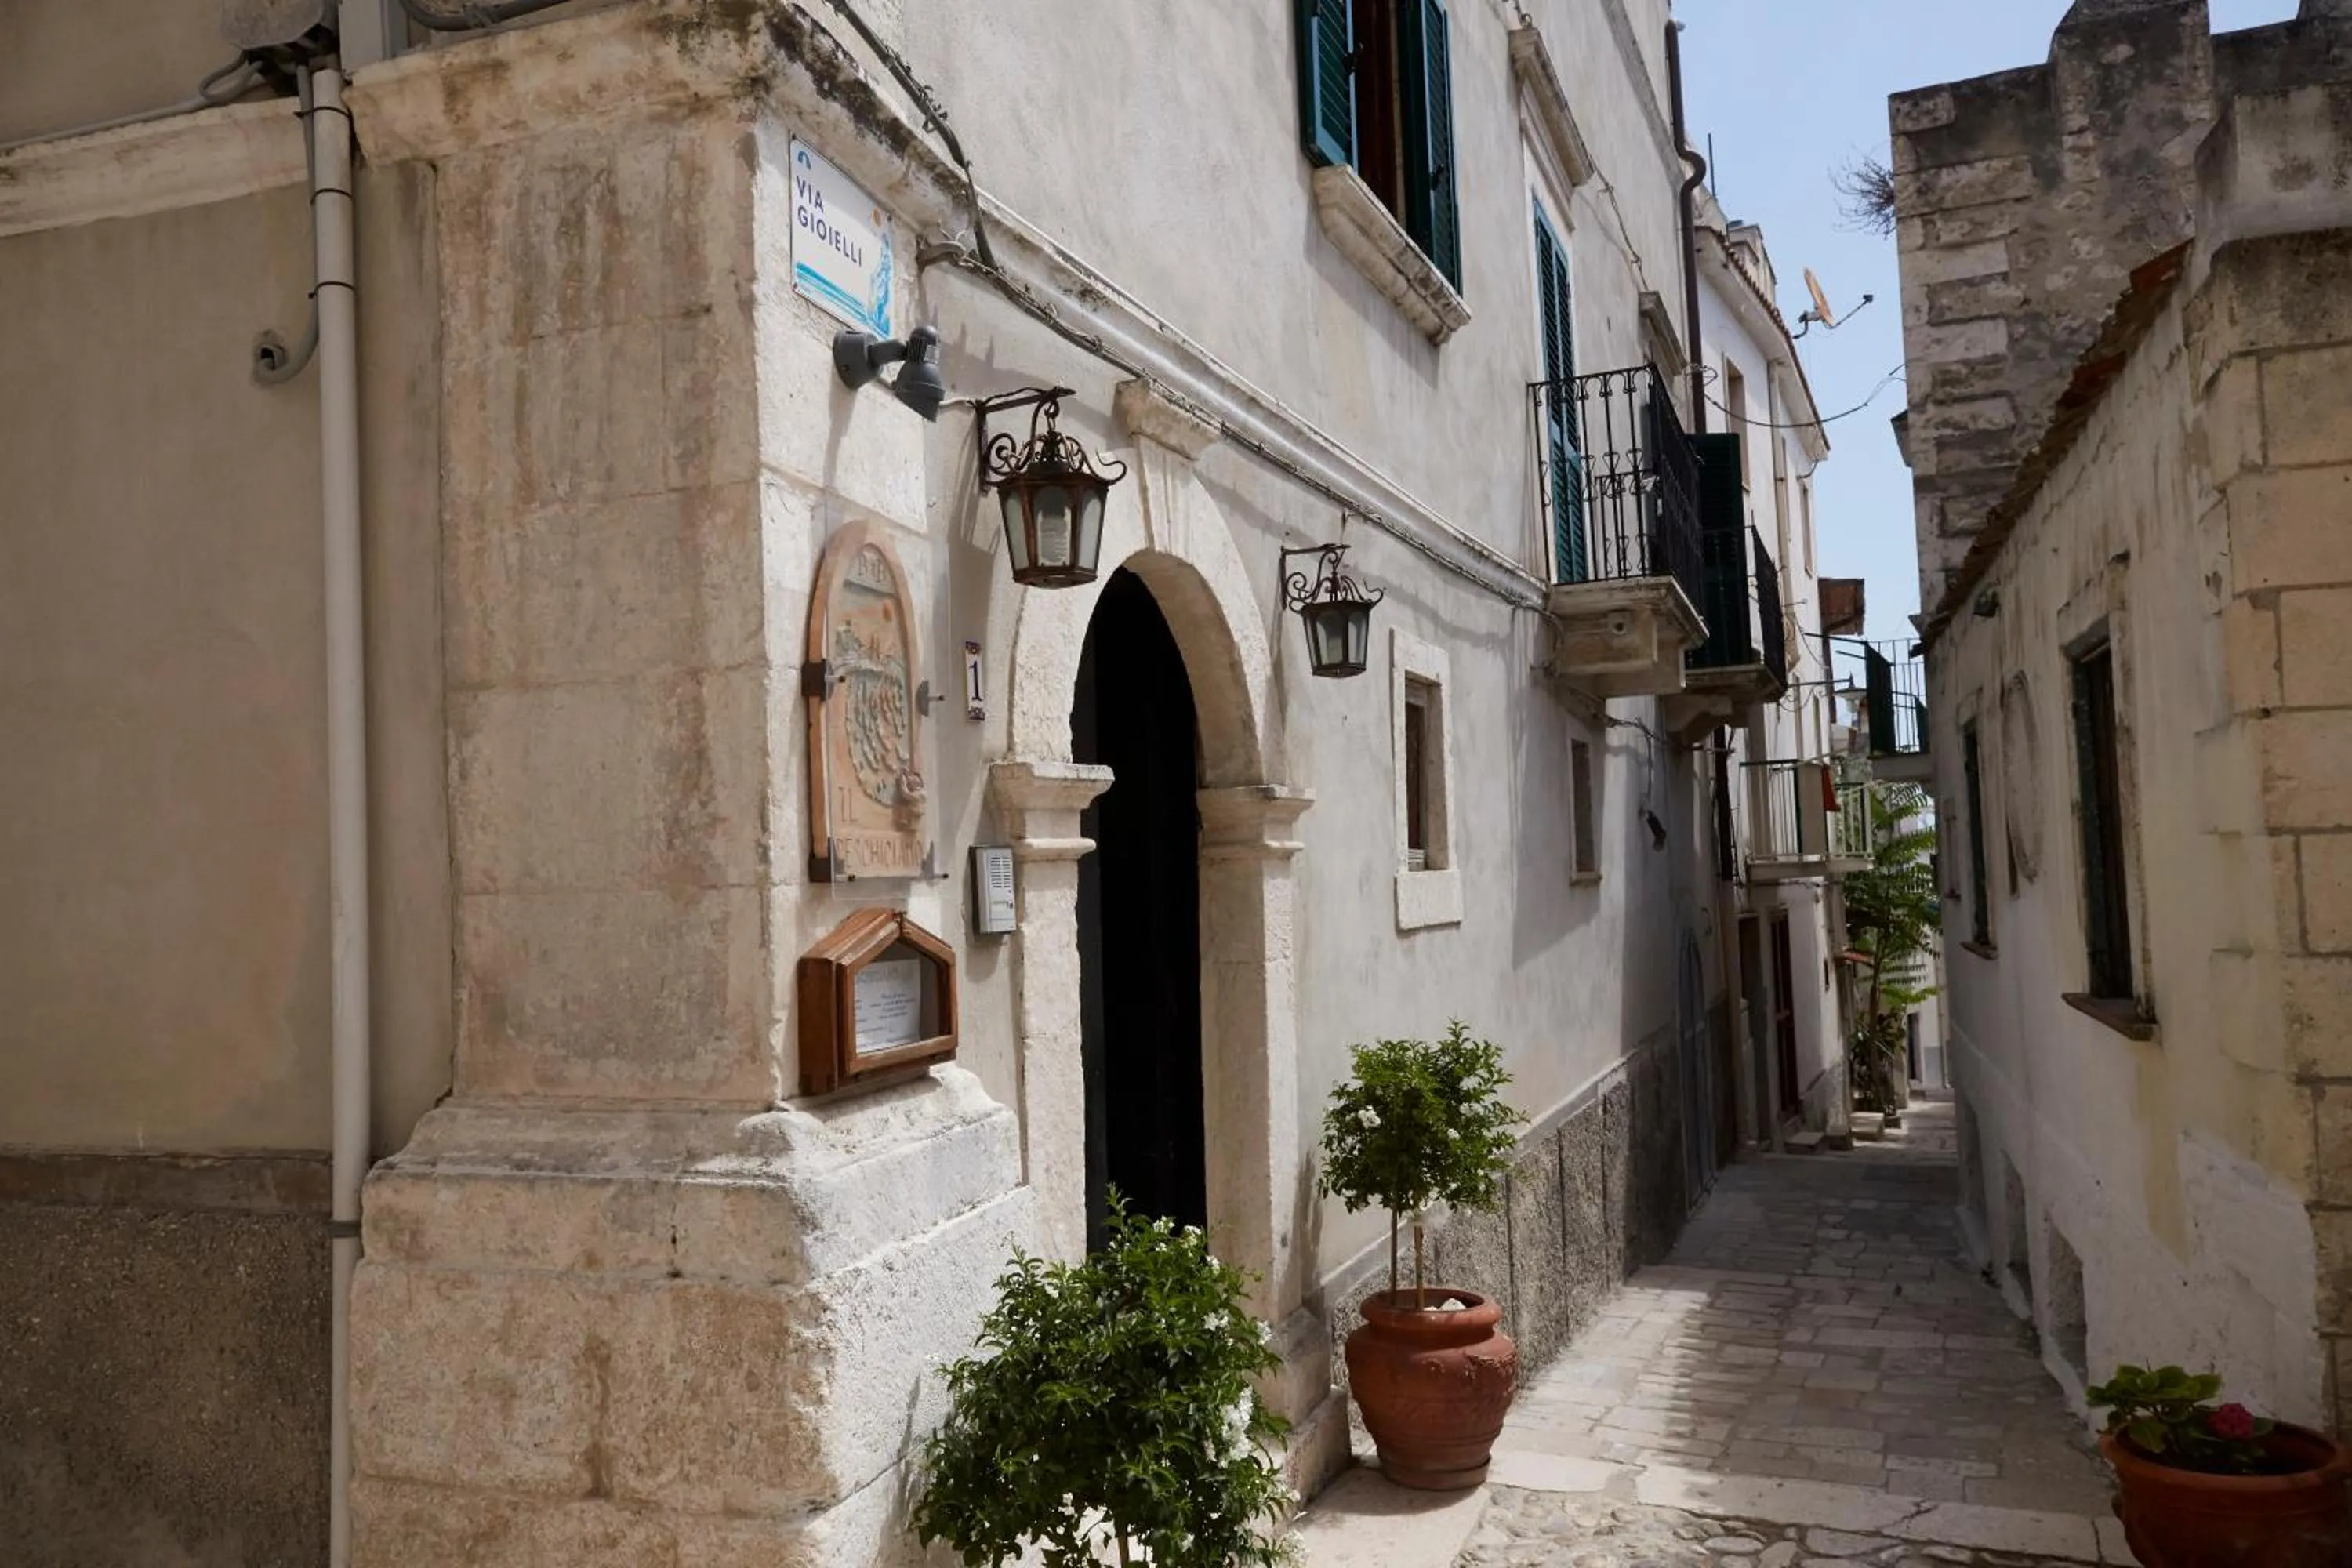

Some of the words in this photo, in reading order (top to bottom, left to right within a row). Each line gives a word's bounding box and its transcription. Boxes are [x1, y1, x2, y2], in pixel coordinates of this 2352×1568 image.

[797, 175, 825, 213] VIA
[797, 205, 862, 267] GIOIELLI
[969, 661, 984, 702] 1
